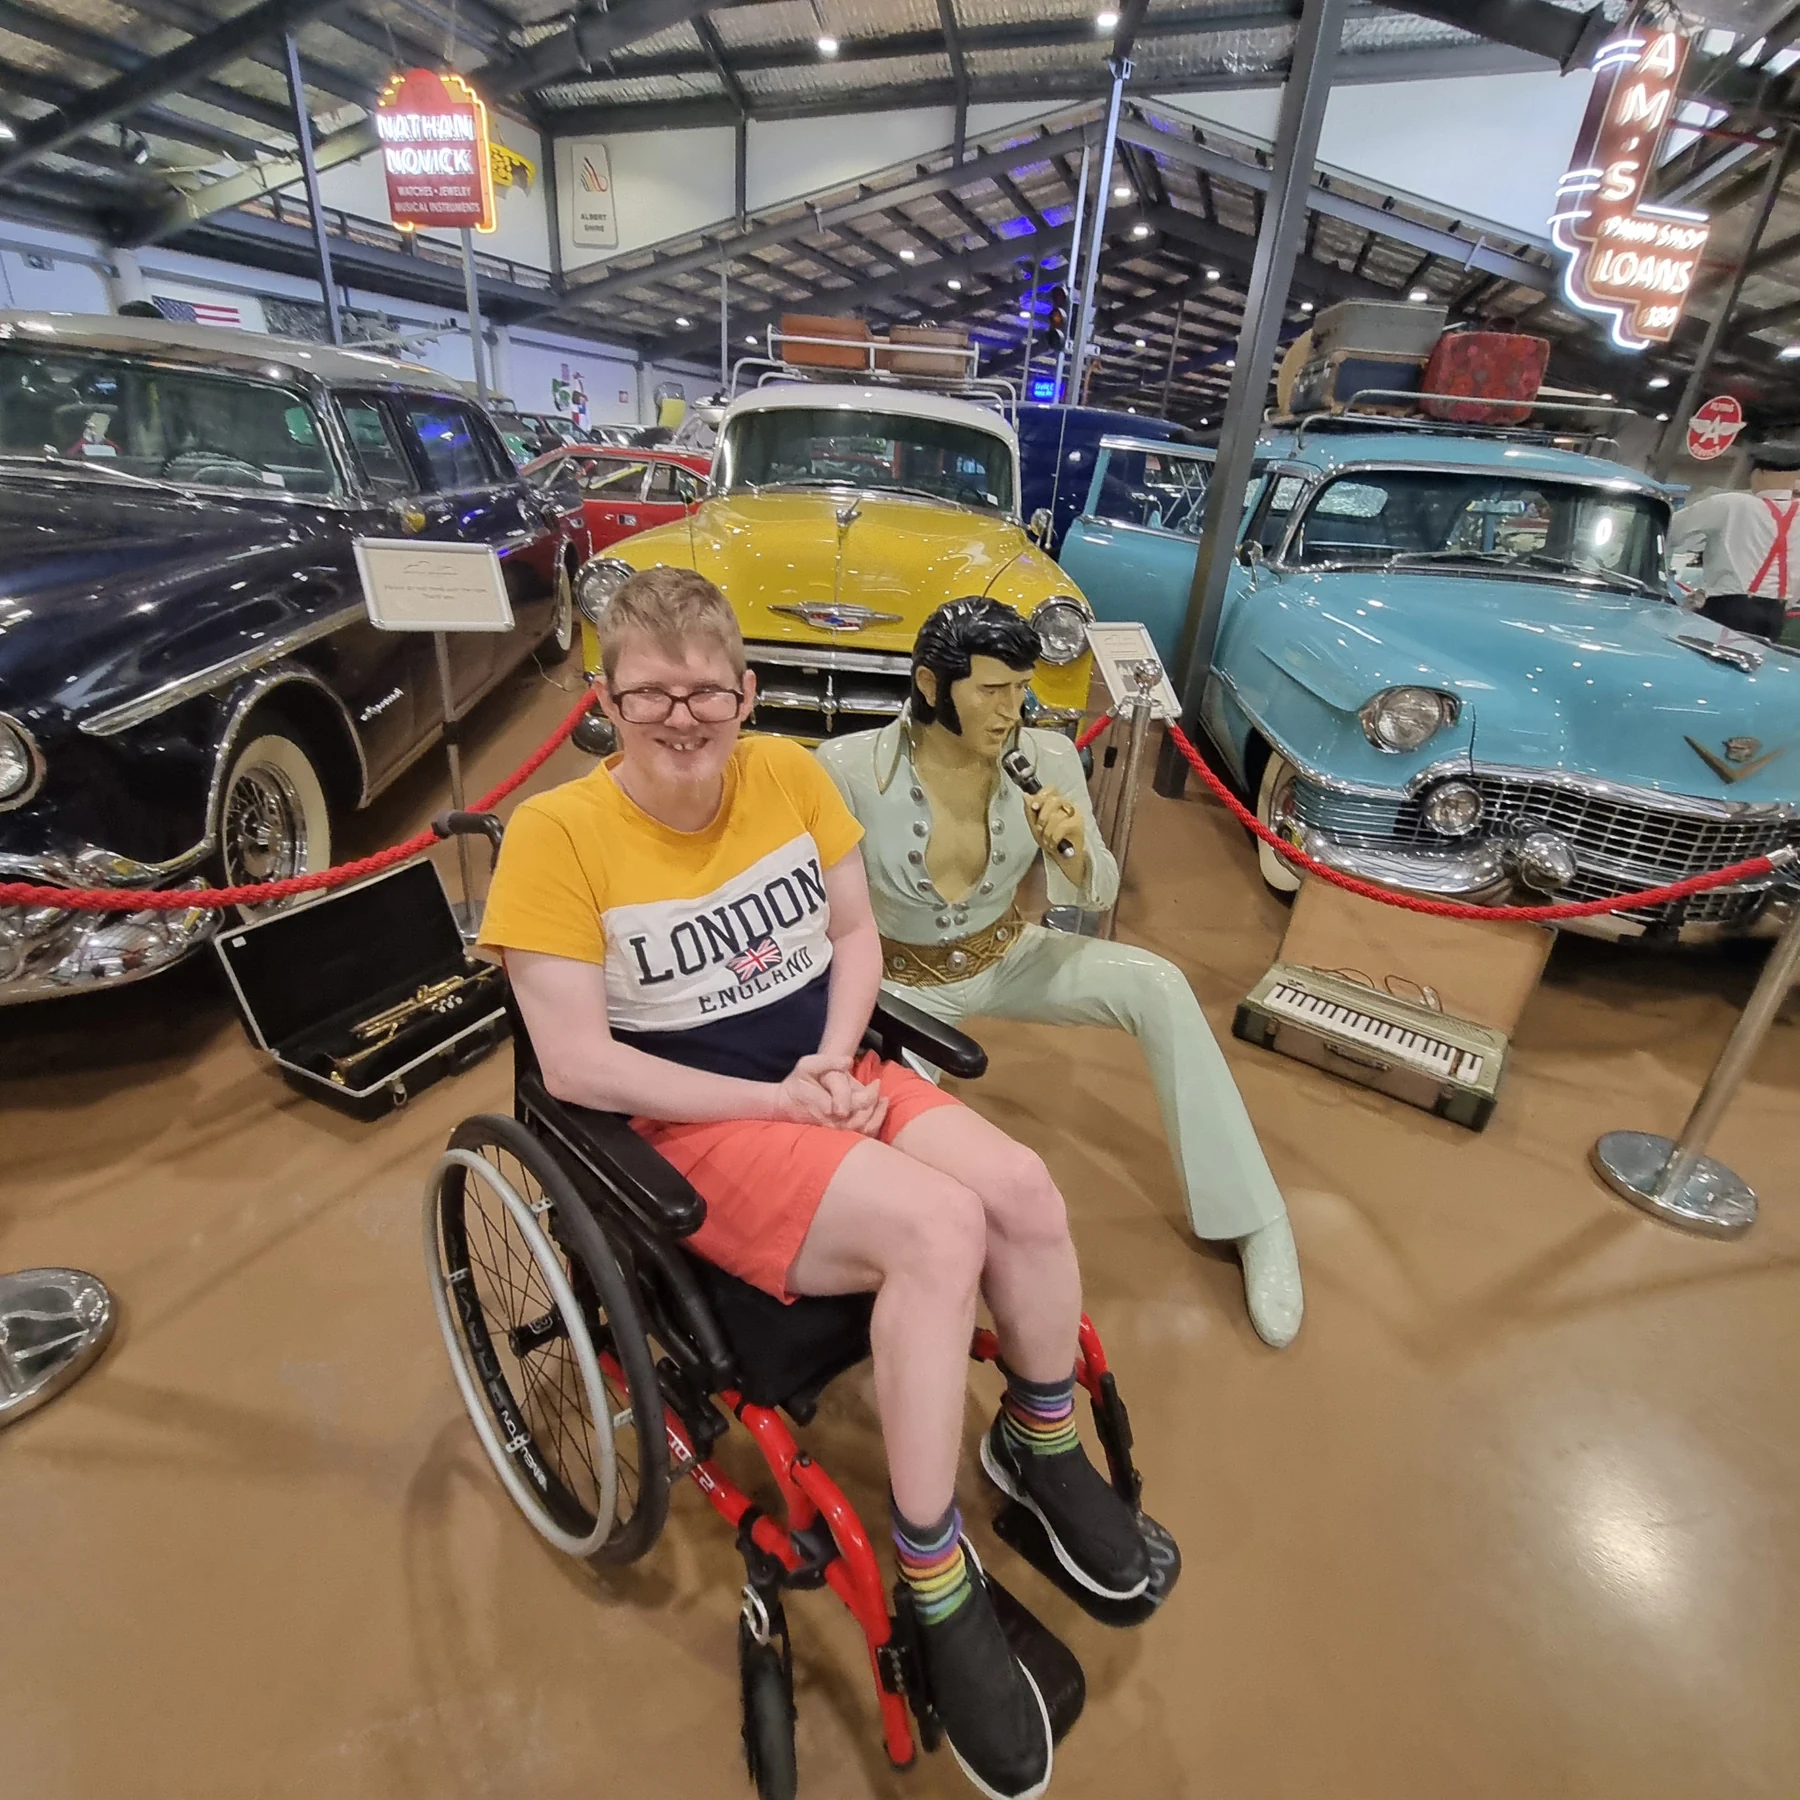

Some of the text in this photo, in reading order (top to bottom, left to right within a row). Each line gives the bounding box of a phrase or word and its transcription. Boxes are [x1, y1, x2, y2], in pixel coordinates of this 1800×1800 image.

[376, 113, 475, 141] NATHAN
[385, 147, 474, 175] NOVICK
[397, 186, 471, 197] WATCHES JEWELRY
[395, 202, 480, 213] MUSICAL INSTRUMENTS
[1604, 216, 1708, 250] PAWN SHOP
[1595, 249, 1693, 294] LOANS
[629, 858, 827, 986] LONDON
[699, 946, 815, 1014] ENGLAND
